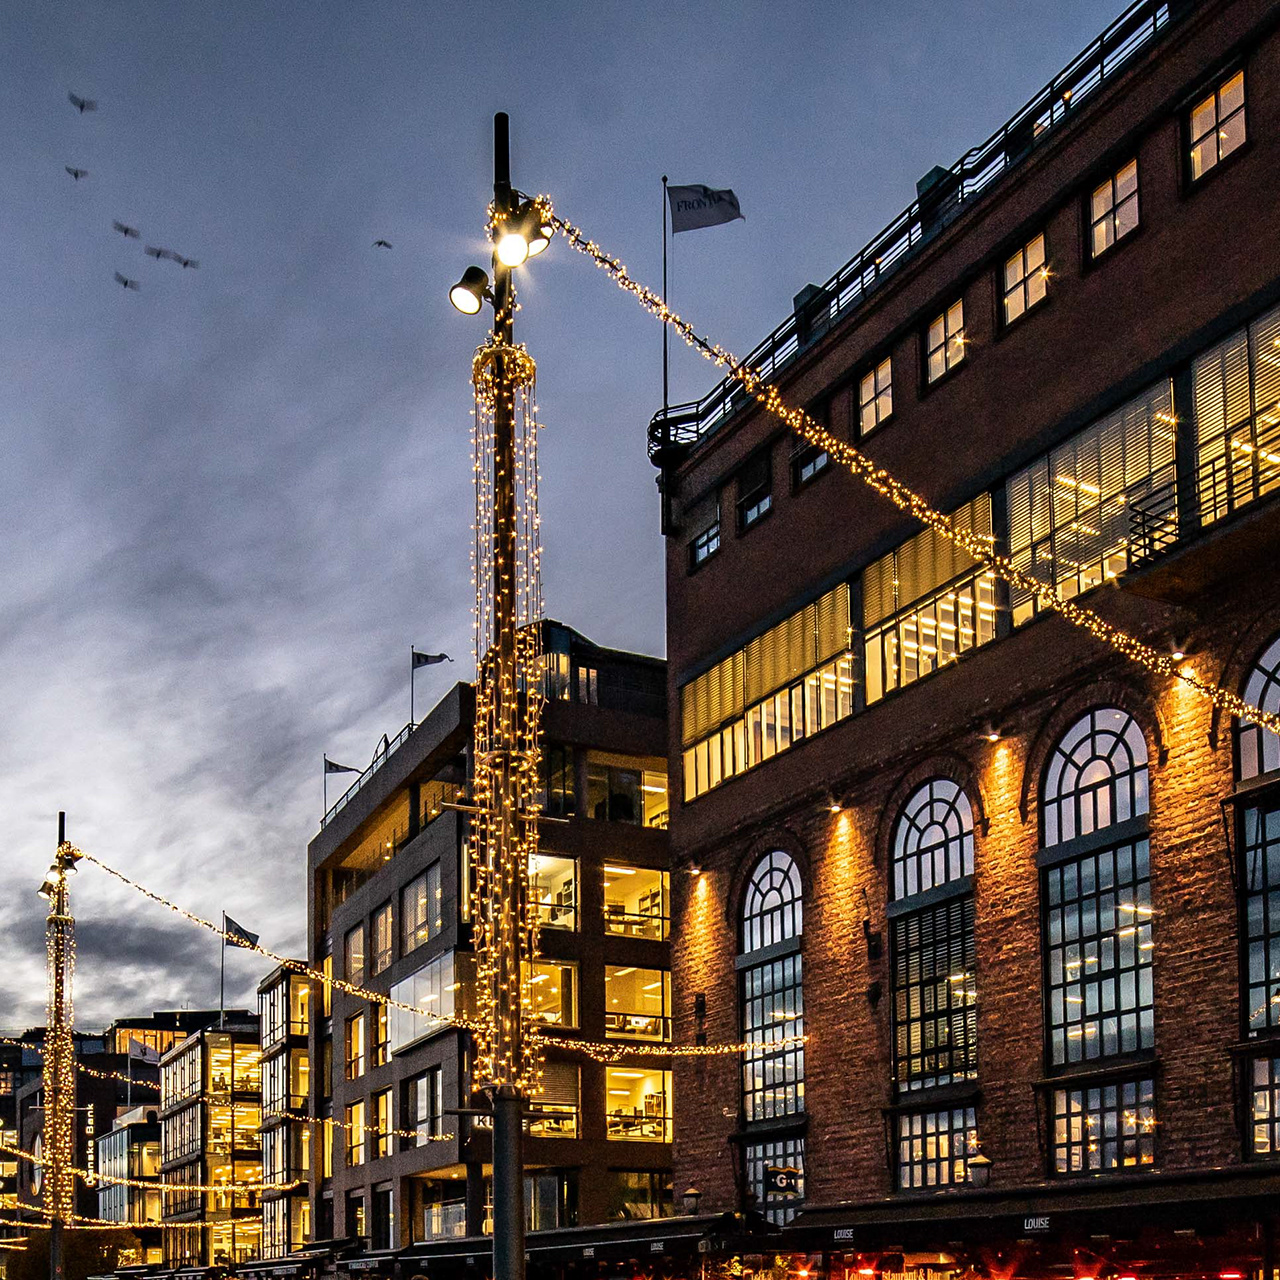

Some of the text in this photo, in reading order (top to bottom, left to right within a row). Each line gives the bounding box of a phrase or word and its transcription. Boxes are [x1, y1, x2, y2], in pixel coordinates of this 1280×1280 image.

[86, 1103, 94, 1134] Bank
[1024, 1217, 1050, 1229] LOUISE
[834, 1228, 854, 1239] LOUISE
